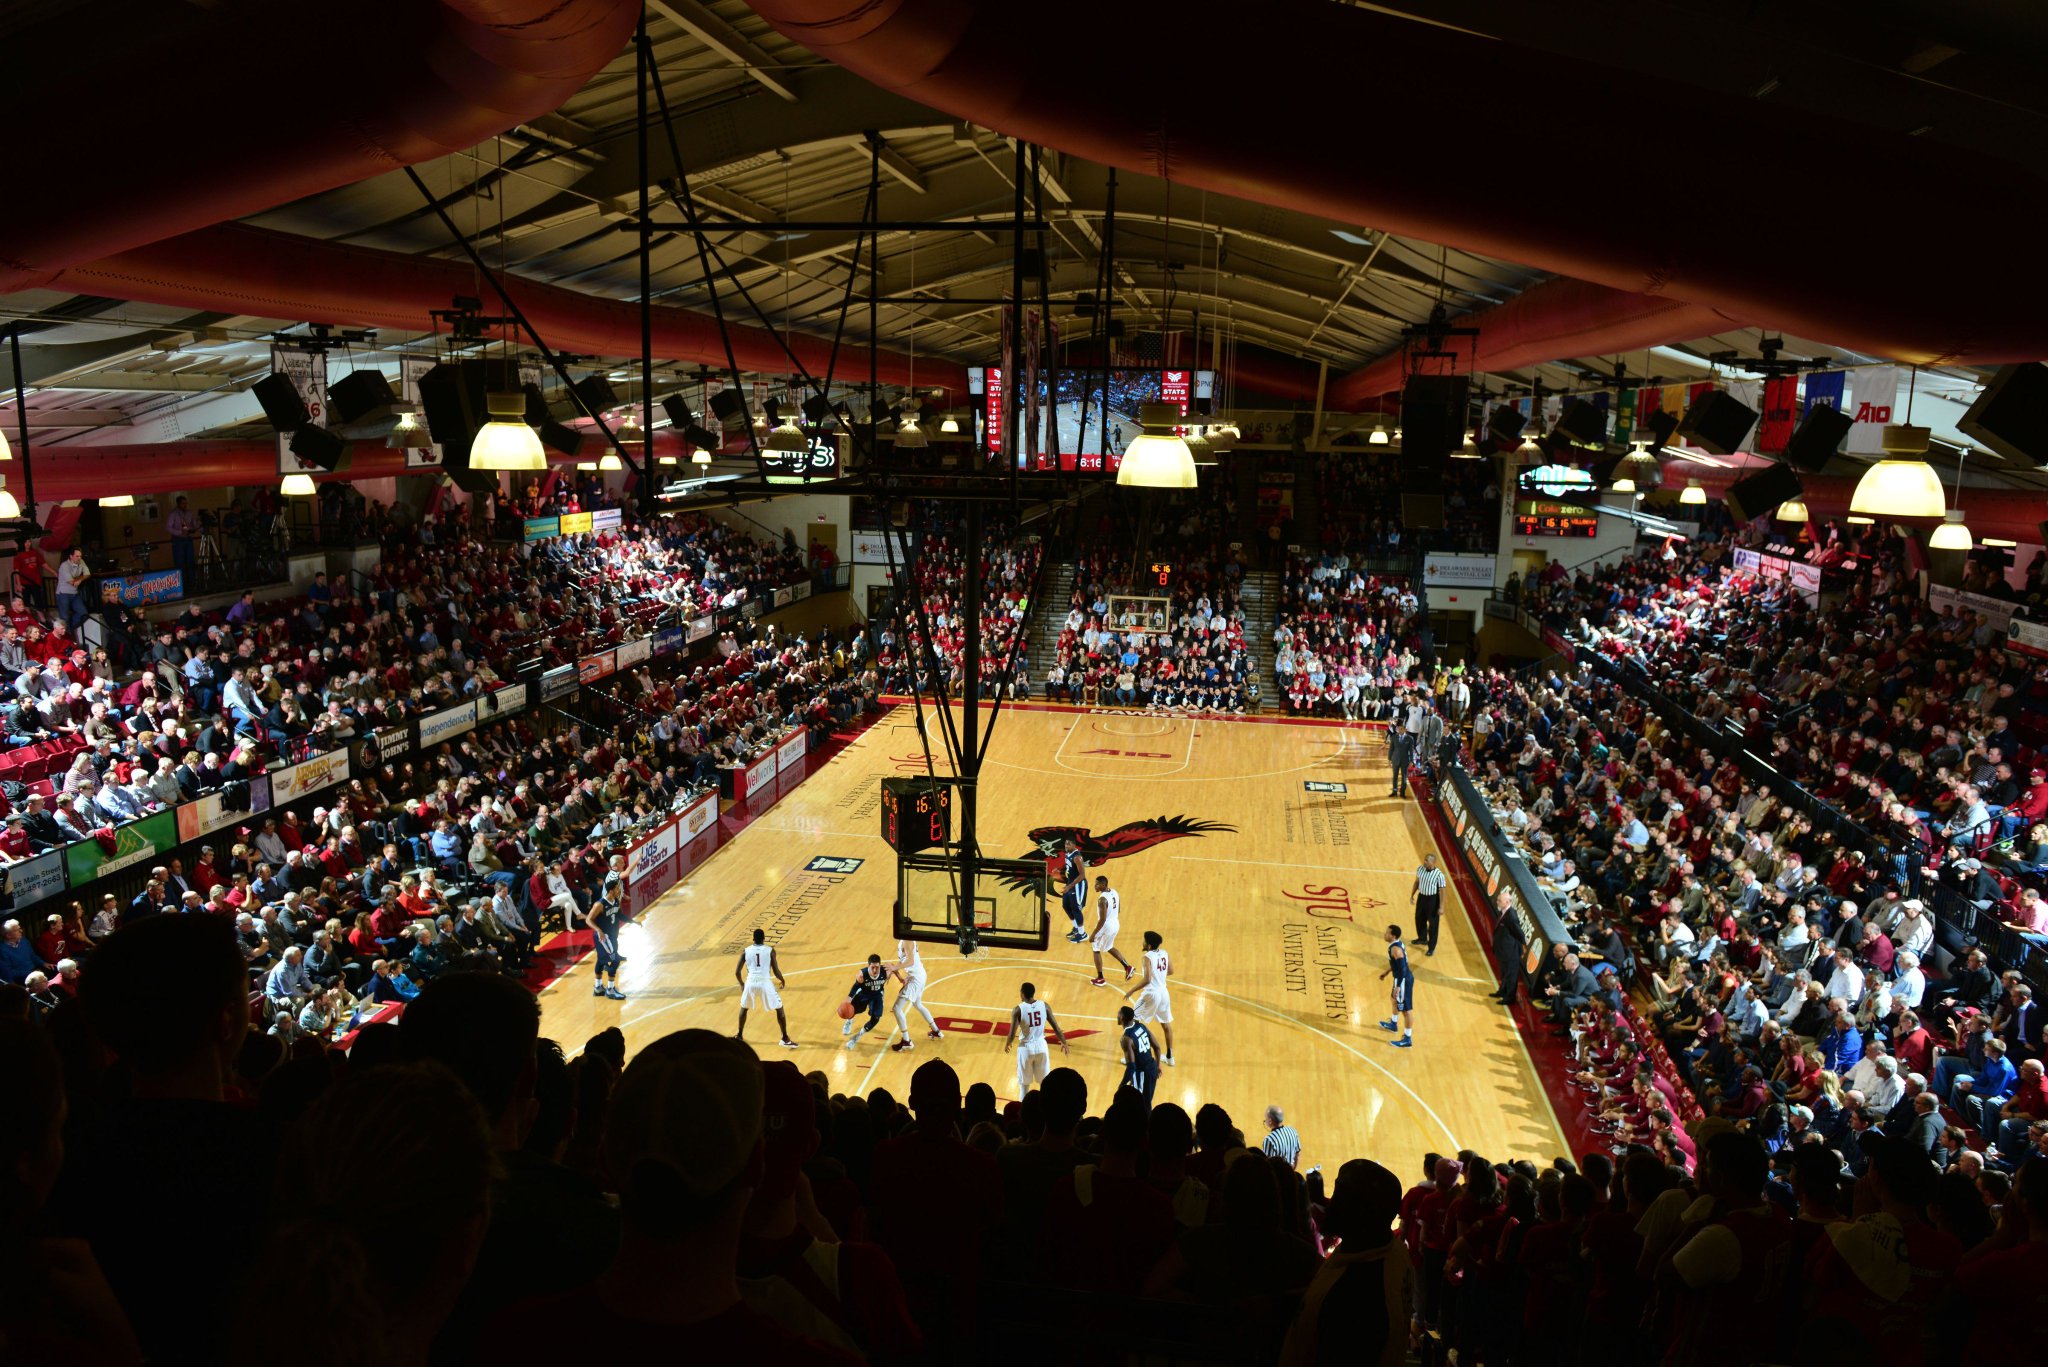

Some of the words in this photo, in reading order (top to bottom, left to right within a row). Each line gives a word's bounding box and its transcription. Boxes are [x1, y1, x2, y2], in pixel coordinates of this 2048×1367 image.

[1854, 402, 1891, 424] A10
[1560, 506, 1584, 514] zero
[1159, 572, 1167, 586] 8
[495, 686, 525, 706] inancial
[1089, 708, 1189, 718] HAWKS
[420, 713, 468, 738] Independence
[380, 728, 409, 750] JIMMY
[380, 741, 410, 763] JOHN'S
[641, 839, 658, 863] Lids
[650, 847, 668, 867] Sports
[24, 873, 41, 885] Main
[41, 865, 62, 880] Street
[765, 874, 847, 947] PHILADELPH
[1281, 883, 1354, 923] SJU
[1315, 925, 1342, 959] SAINT
[1156, 956, 1167, 972] 43
[1281, 922, 1308, 996] UNIVERSITY
[1312, 959, 1349, 1021] JOSEPH'S
[1027, 1010, 1042, 1028] 15
[1138, 1034, 1151, 1054] 45
